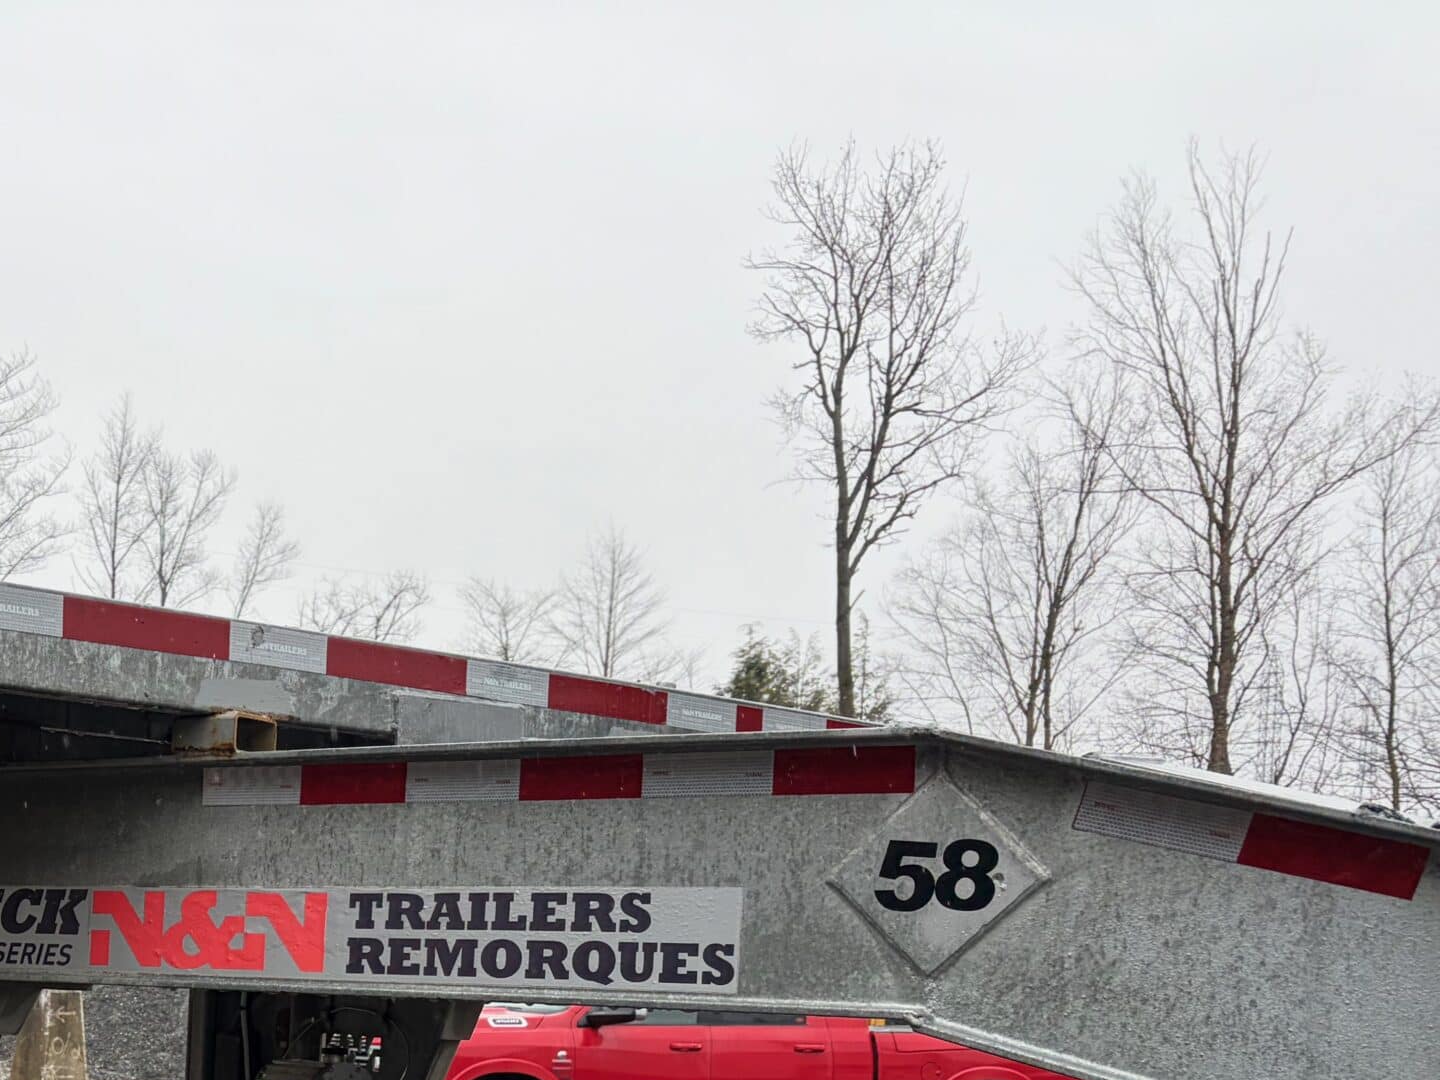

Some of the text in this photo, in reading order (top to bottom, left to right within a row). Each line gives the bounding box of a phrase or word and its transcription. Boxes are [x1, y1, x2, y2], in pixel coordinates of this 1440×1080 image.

[874, 838, 999, 912] 58
[90, 891, 327, 972] N&N
[349, 892, 652, 934] TRAILERS
[346, 937, 735, 986] REMORQUES
